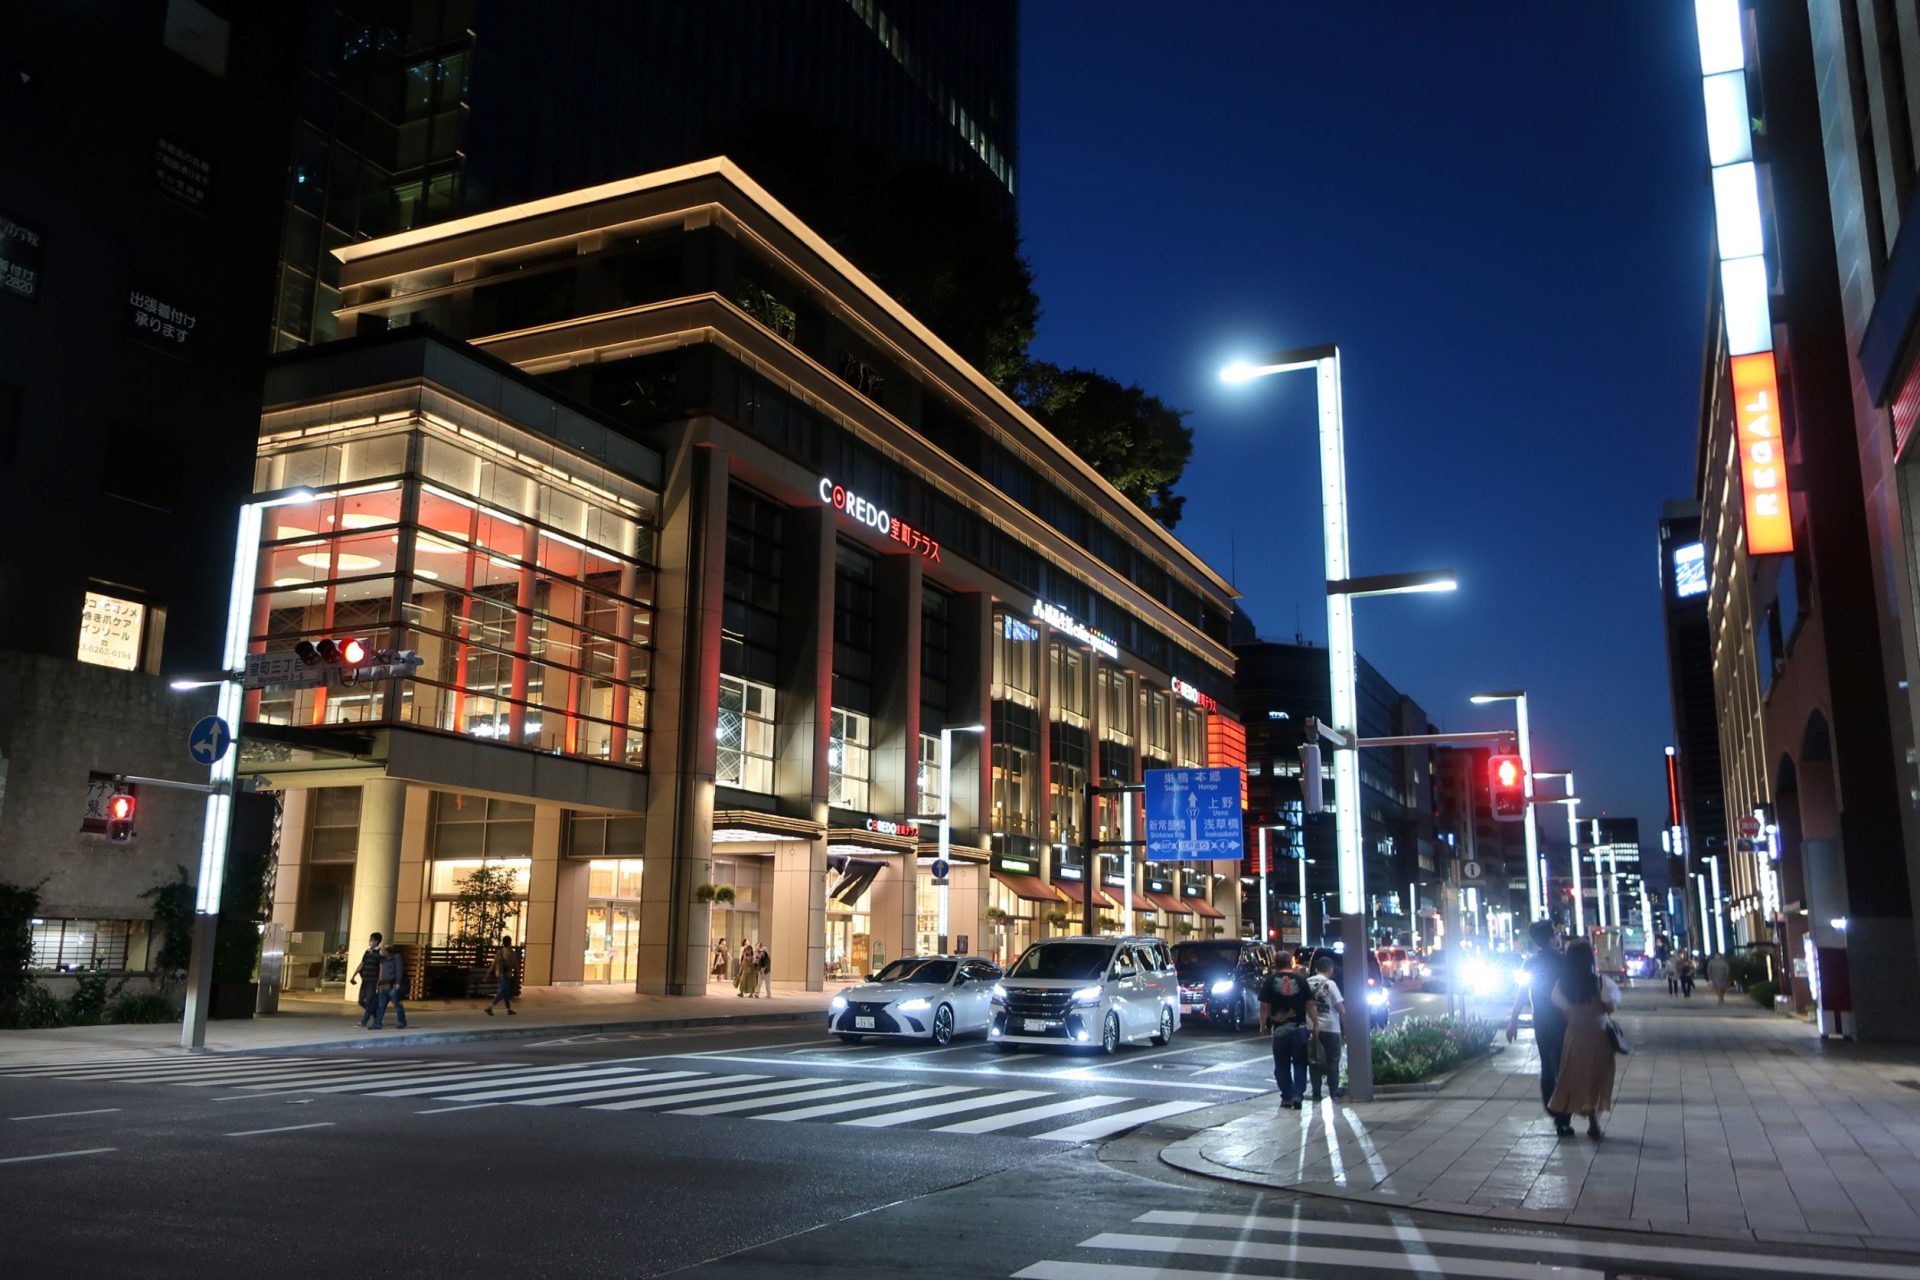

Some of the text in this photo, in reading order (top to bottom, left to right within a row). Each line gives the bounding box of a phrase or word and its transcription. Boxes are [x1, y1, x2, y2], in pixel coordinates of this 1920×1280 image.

[129, 291, 197, 329] 出張着付け
[134, 311, 189, 343] 承ります
[1746, 390, 1778, 516] REGAL
[81, 624, 130, 641] インソール
[1195, 771, 1221, 782] 本郷
[1208, 796, 1234, 809] 上野
[1189, 809, 1197, 817] 17
[1204, 818, 1239, 830] 浅草橋
